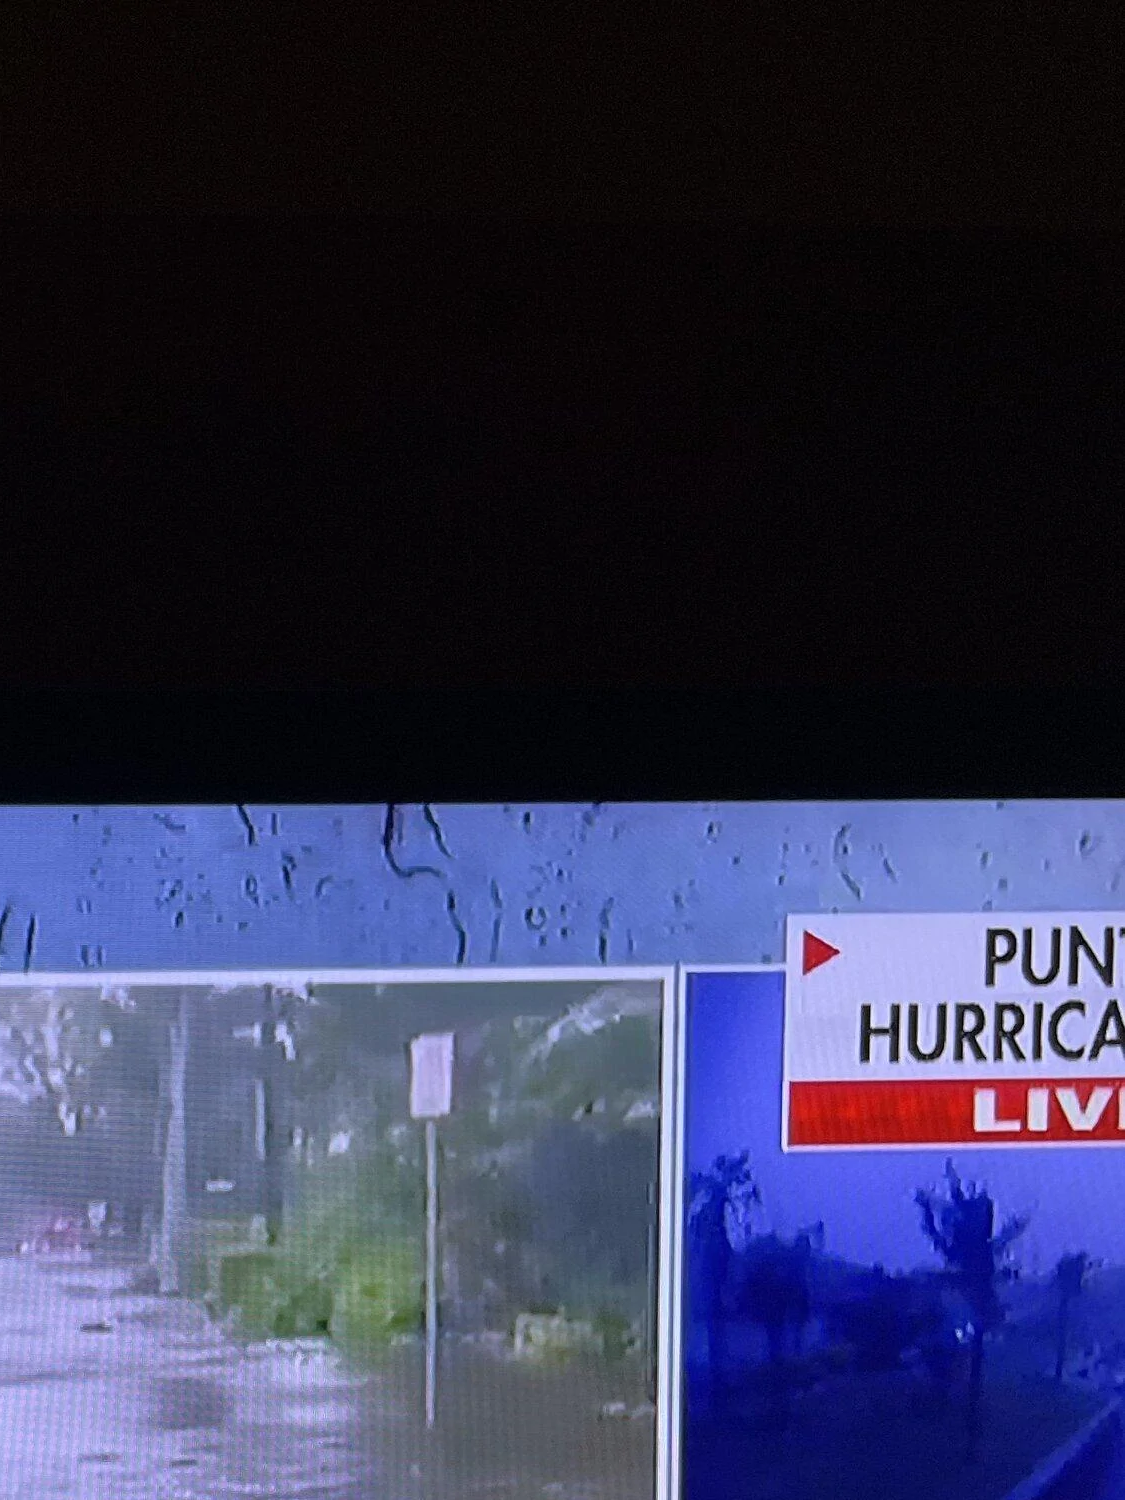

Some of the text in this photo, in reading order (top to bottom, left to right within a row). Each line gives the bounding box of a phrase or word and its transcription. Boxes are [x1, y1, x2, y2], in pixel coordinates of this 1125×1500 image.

[985, 926, 1125, 987] PUN
[859, 999, 1125, 1064] HURRICA
[974, 1087, 1125, 1132] LIV
